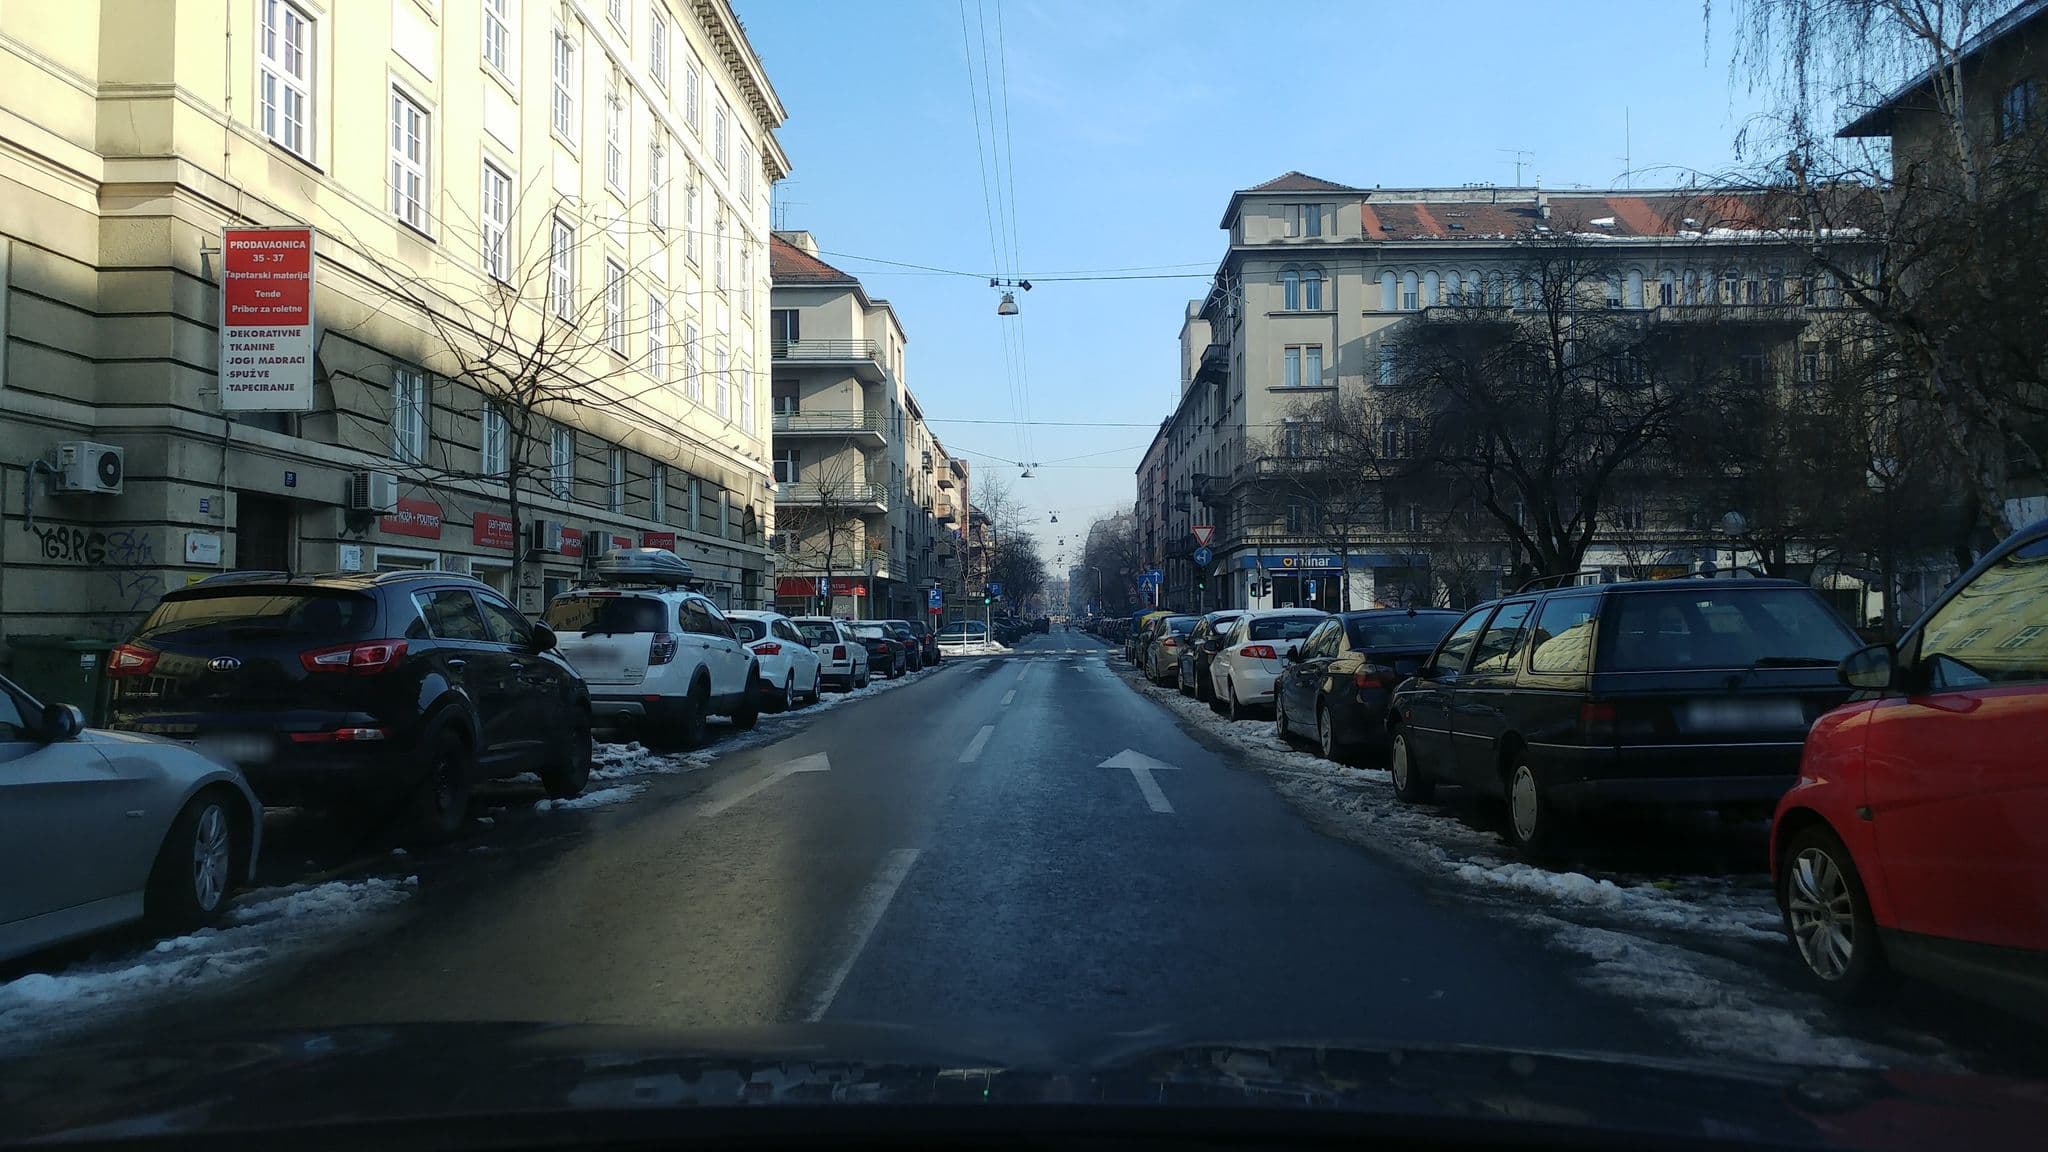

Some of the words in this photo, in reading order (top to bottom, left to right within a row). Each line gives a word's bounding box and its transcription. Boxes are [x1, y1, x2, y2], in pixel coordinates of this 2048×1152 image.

[230, 240, 306, 249] PRODAVAONICA
[252, 254, 265, 262] 35
[272, 254, 285, 262] 37
[225, 270, 271, 280] Tapetarski
[273, 271, 310, 280] materijal
[255, 290, 281, 298] Tende
[232, 305, 259, 313] Pribor
[272, 305, 303, 313] roletne
[230, 343, 275, 351] TKANINE
[258, 356, 305, 364] MADRACI
[1293, 556, 1331, 567] mlinar
[930, 590, 937, 599] P
[212, 660, 233, 669] KIA
